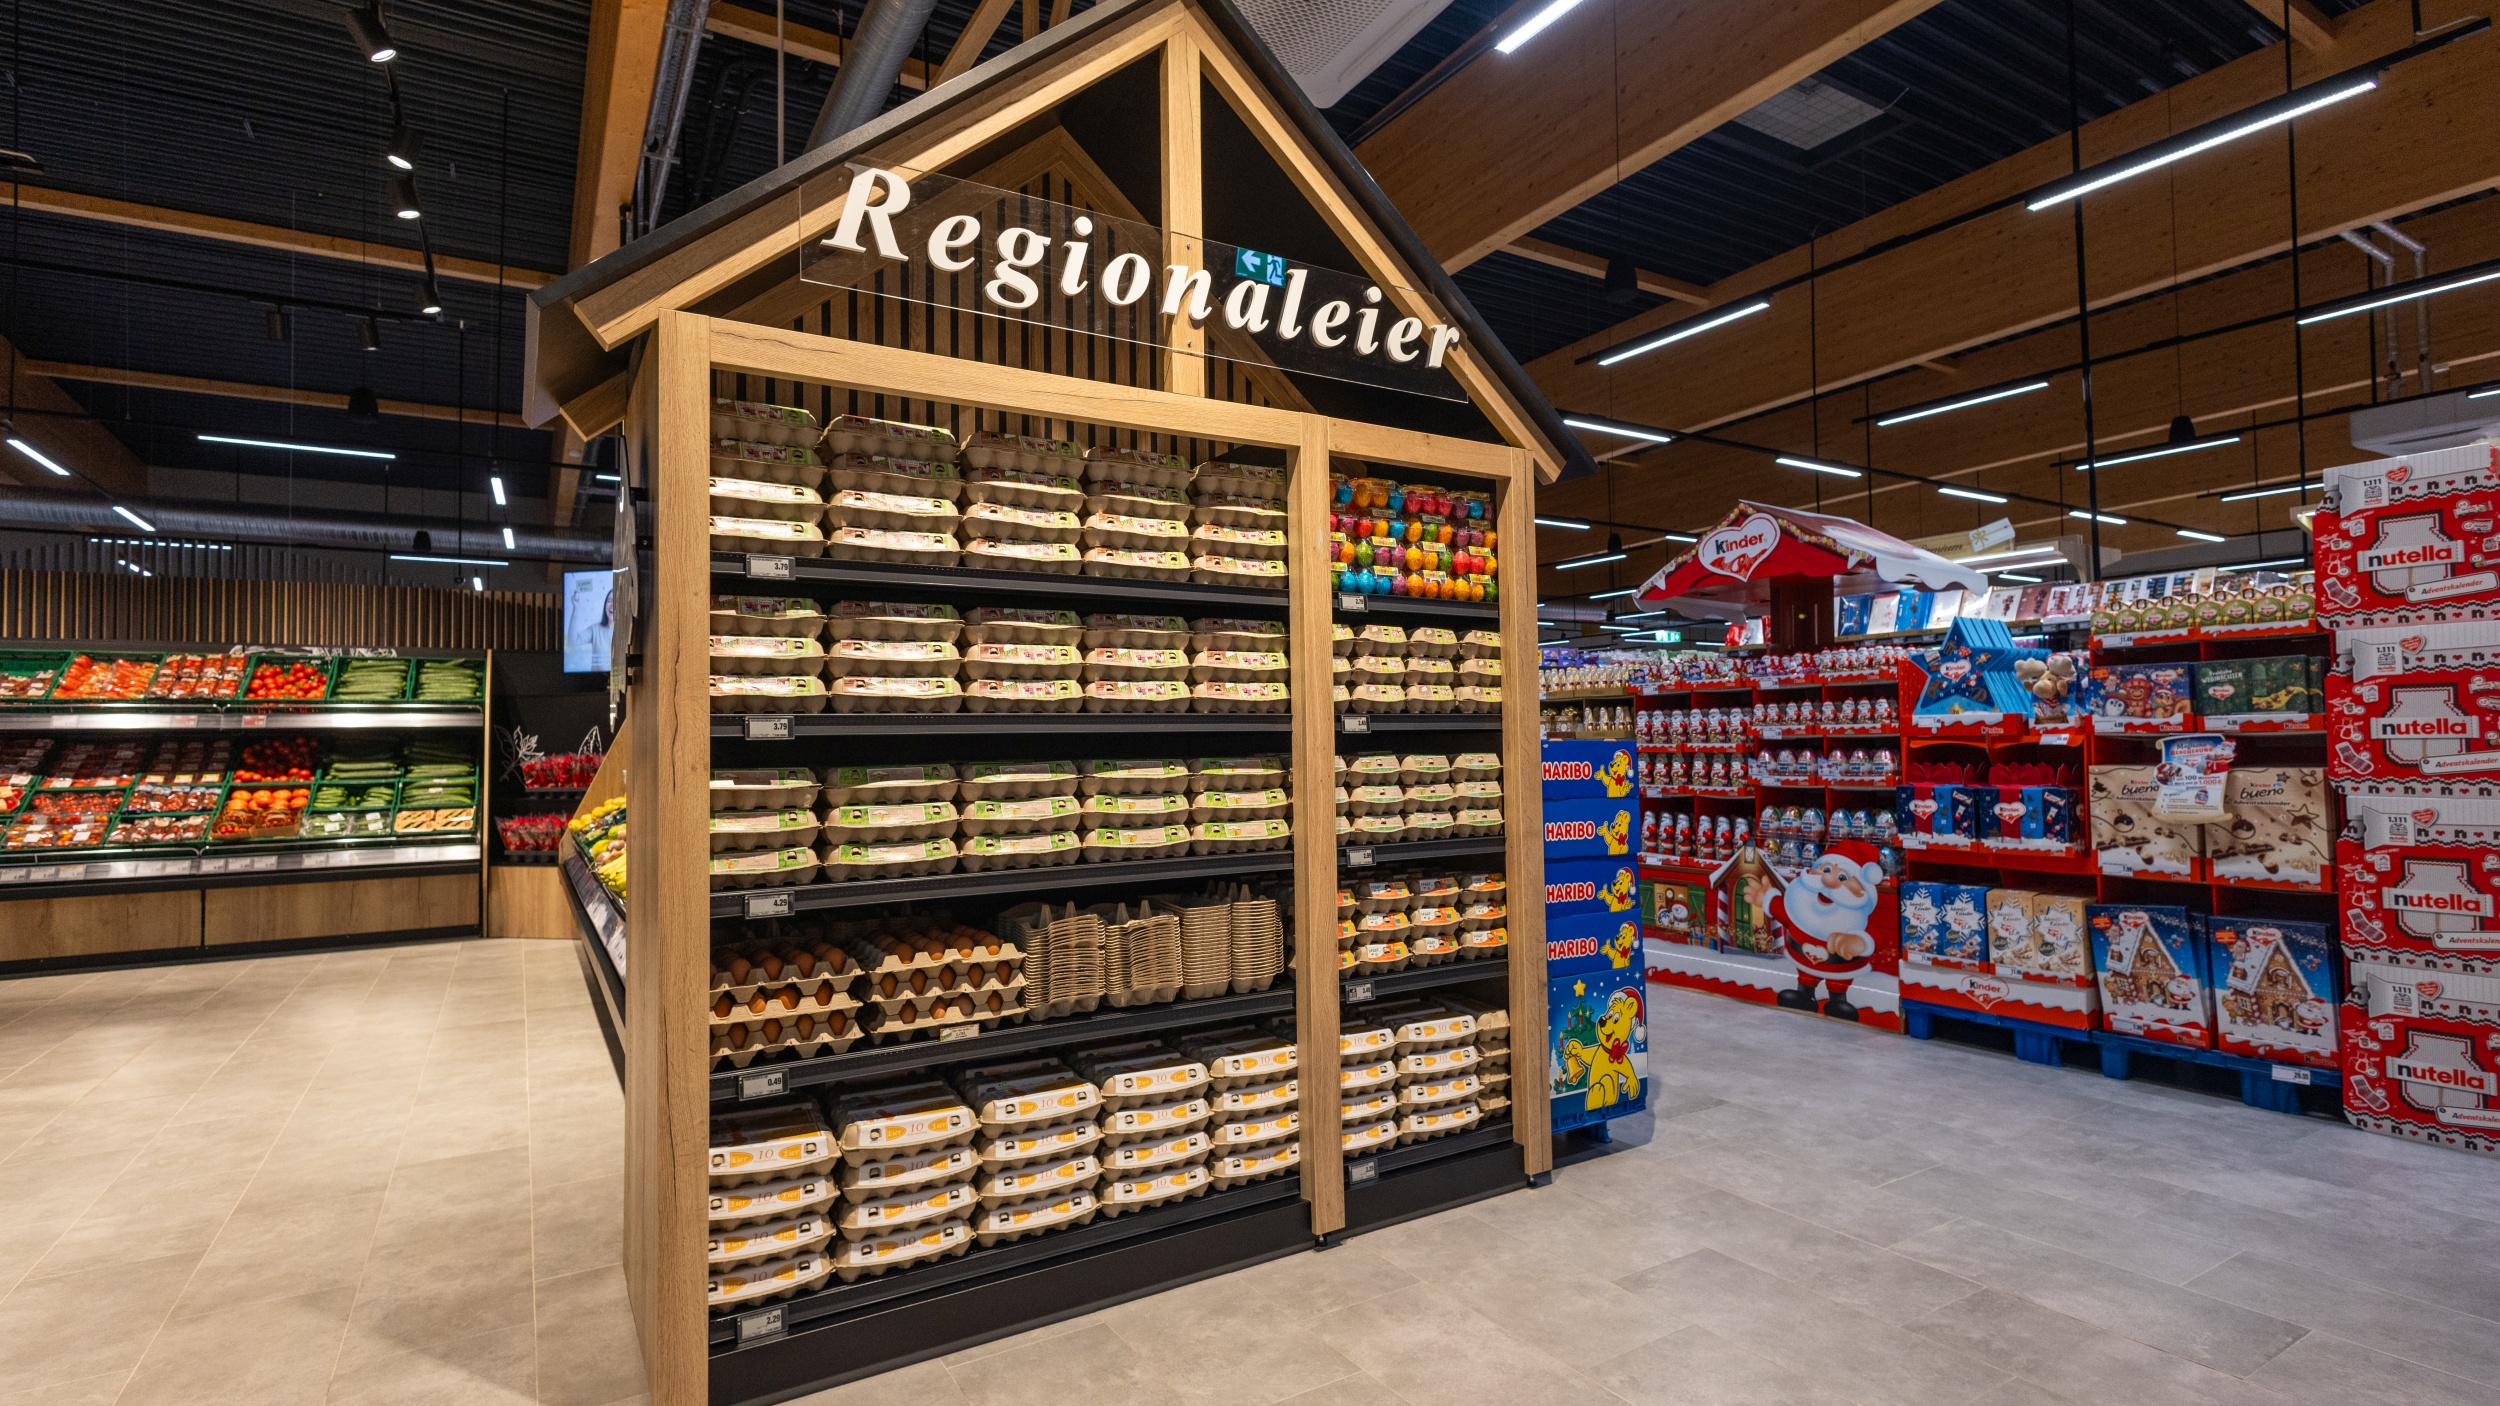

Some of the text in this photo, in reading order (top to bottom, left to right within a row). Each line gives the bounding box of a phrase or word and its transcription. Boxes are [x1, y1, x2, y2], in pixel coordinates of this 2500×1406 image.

[819, 161, 1462, 369] Regionaleier
[1715, 533, 1763, 555] kinder
[2369, 545, 2452, 567] nutella
[2422, 580, 2483, 594] Adventskalender
[2382, 718, 2467, 735] nutella
[2436, 758, 2498, 767] Adventskalender
[1543, 762, 1591, 780] HARIBO
[2121, 784, 2159, 795] bueno
[2240, 786, 2284, 800] bueno
[1546, 821, 1594, 840] HARIBO
[1546, 882, 1594, 903] HARIBO
[2394, 894, 2480, 912] nutella
[1548, 937, 1597, 960] HARIBO
[1970, 979, 2001, 993] kinder
[1261, 1056, 1270, 1064] 10
[768, 1078, 781, 1086] 0.49
[2398, 1064, 2484, 1090] nutella
[1260, 1090, 1270, 1098] 10
[1041, 1099, 1053, 1107] 10
[1158, 1110, 1167, 1118] 10
[911, 1123, 923, 1132] 10
[1041, 1135, 1052, 1143] 10
[1157, 1145, 1167, 1153] 10
[731, 1155, 748, 1164] Eier
[759, 1149, 774, 1159] 10
[784, 1148, 801, 1157] Eier
[1261, 1154, 1270, 1162] 10
[911, 1161, 923, 1170] 10
[1041, 1170, 1052, 1179] 10
[1155, 1178, 1166, 1187] 10
[758, 1192, 772, 1202] 10
[782, 1191, 799, 1199] Eier
[910, 1199, 922, 1209] 10
[1036, 1205, 1048, 1215] 10
[754, 1232, 769, 1242] 10
[903, 1236, 916, 1246] 10
[753, 1272, 767, 1282] 10
[767, 1315, 780, 1324] 2.29
